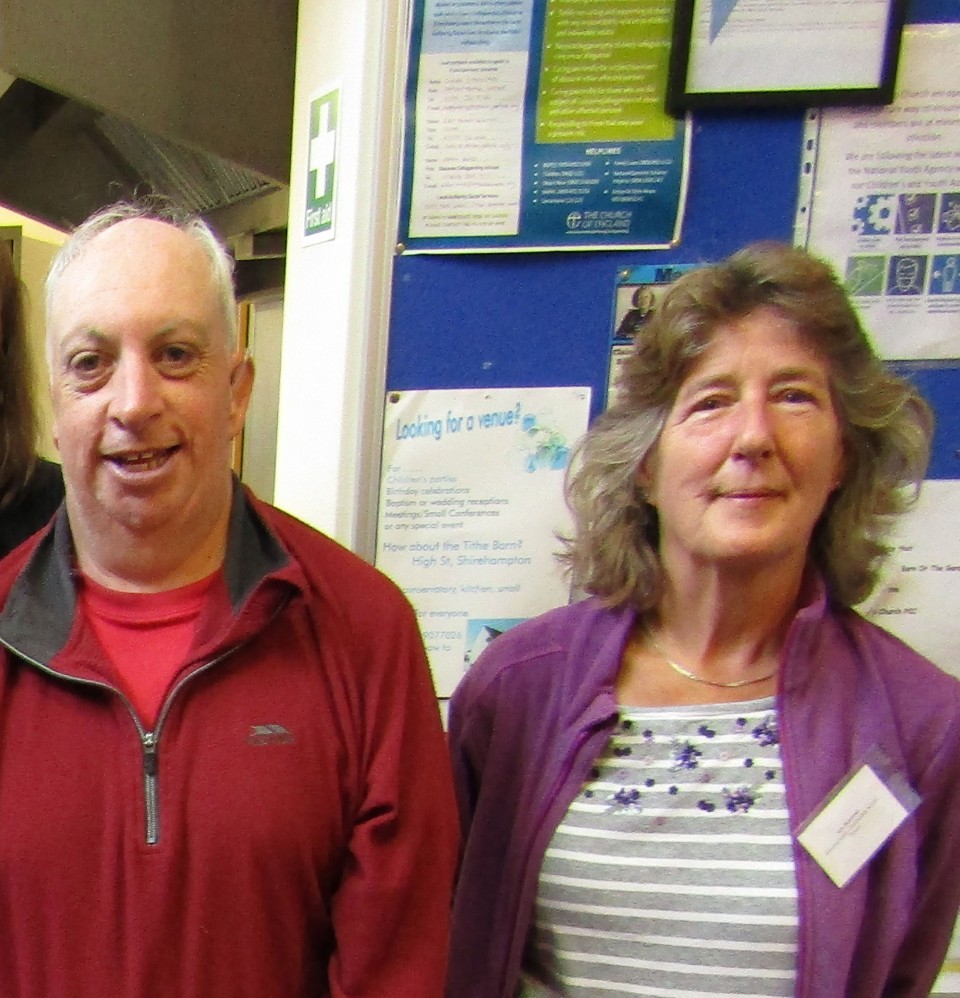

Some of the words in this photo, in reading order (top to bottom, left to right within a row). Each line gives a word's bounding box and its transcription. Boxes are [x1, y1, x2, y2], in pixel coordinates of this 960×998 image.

[396, 414, 442, 441] Looking
[446, 410, 464, 434] for
[466, 415, 474, 432] a
[478, 401, 522, 429] venue?
[430, 498, 465, 507] wedding
[448, 509, 500, 518] Conferences
[382, 542, 407, 552] How
[409, 541, 440, 552] about
[443, 541, 459, 551] the
[463, 541, 489, 551] Tithe
[412, 555, 437, 568] High
[457, 555, 532, 567] Shirehampton
